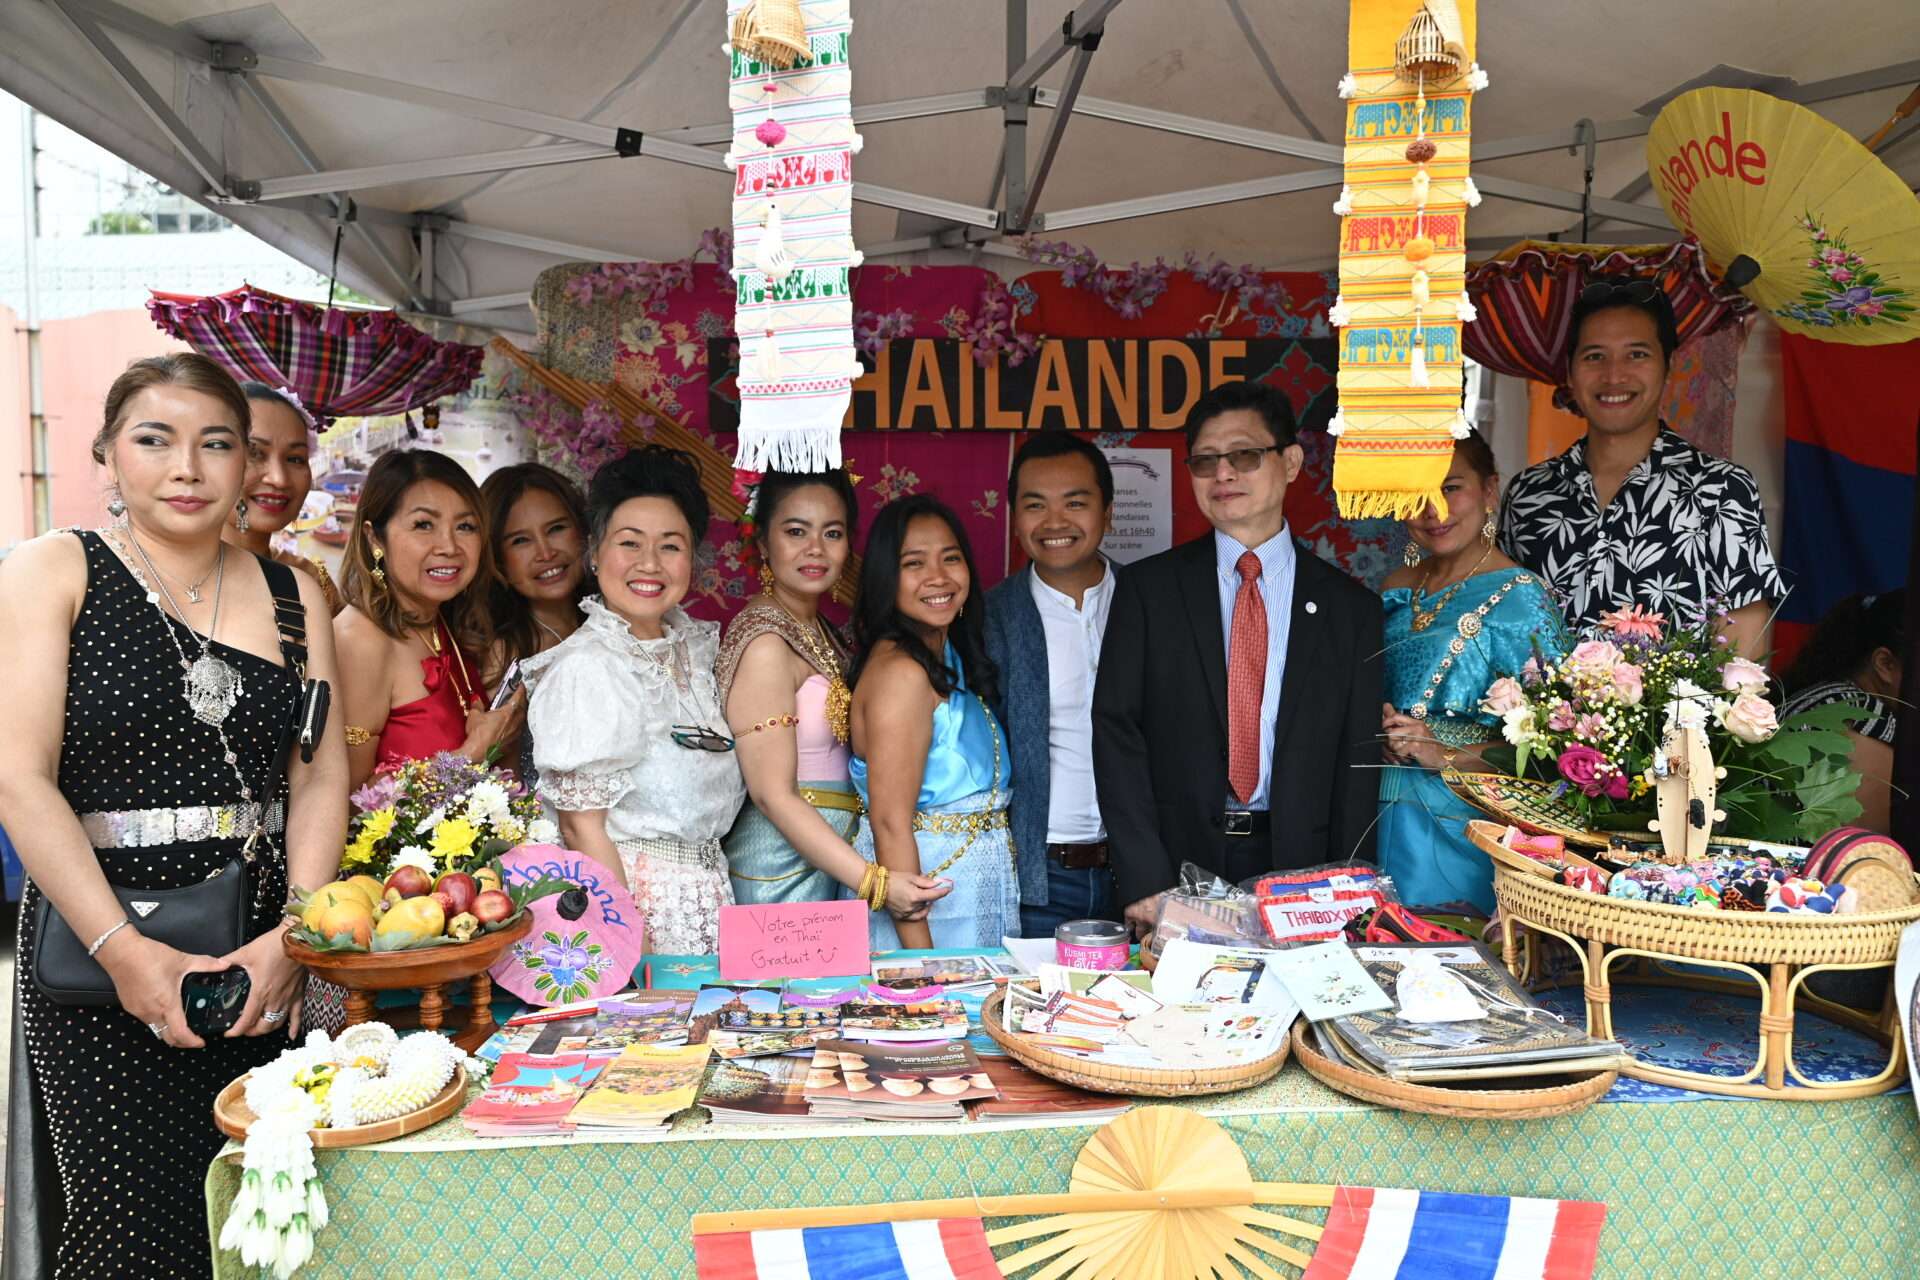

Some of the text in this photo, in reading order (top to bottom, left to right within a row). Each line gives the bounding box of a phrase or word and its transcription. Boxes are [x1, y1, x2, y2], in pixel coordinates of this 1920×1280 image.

[1659, 112, 1767, 236] ailande
[842, 339, 1247, 430] HAILANDE
[1112, 488, 1138, 496] anses
[1112, 512, 1150, 521] landaises
[749, 911, 796, 934] Votre
[774, 935, 789, 944] en
[751, 949, 810, 969] Gratuit
[1087, 951, 1104, 961] TEA
[1067, 958, 1098, 969] LOVE
